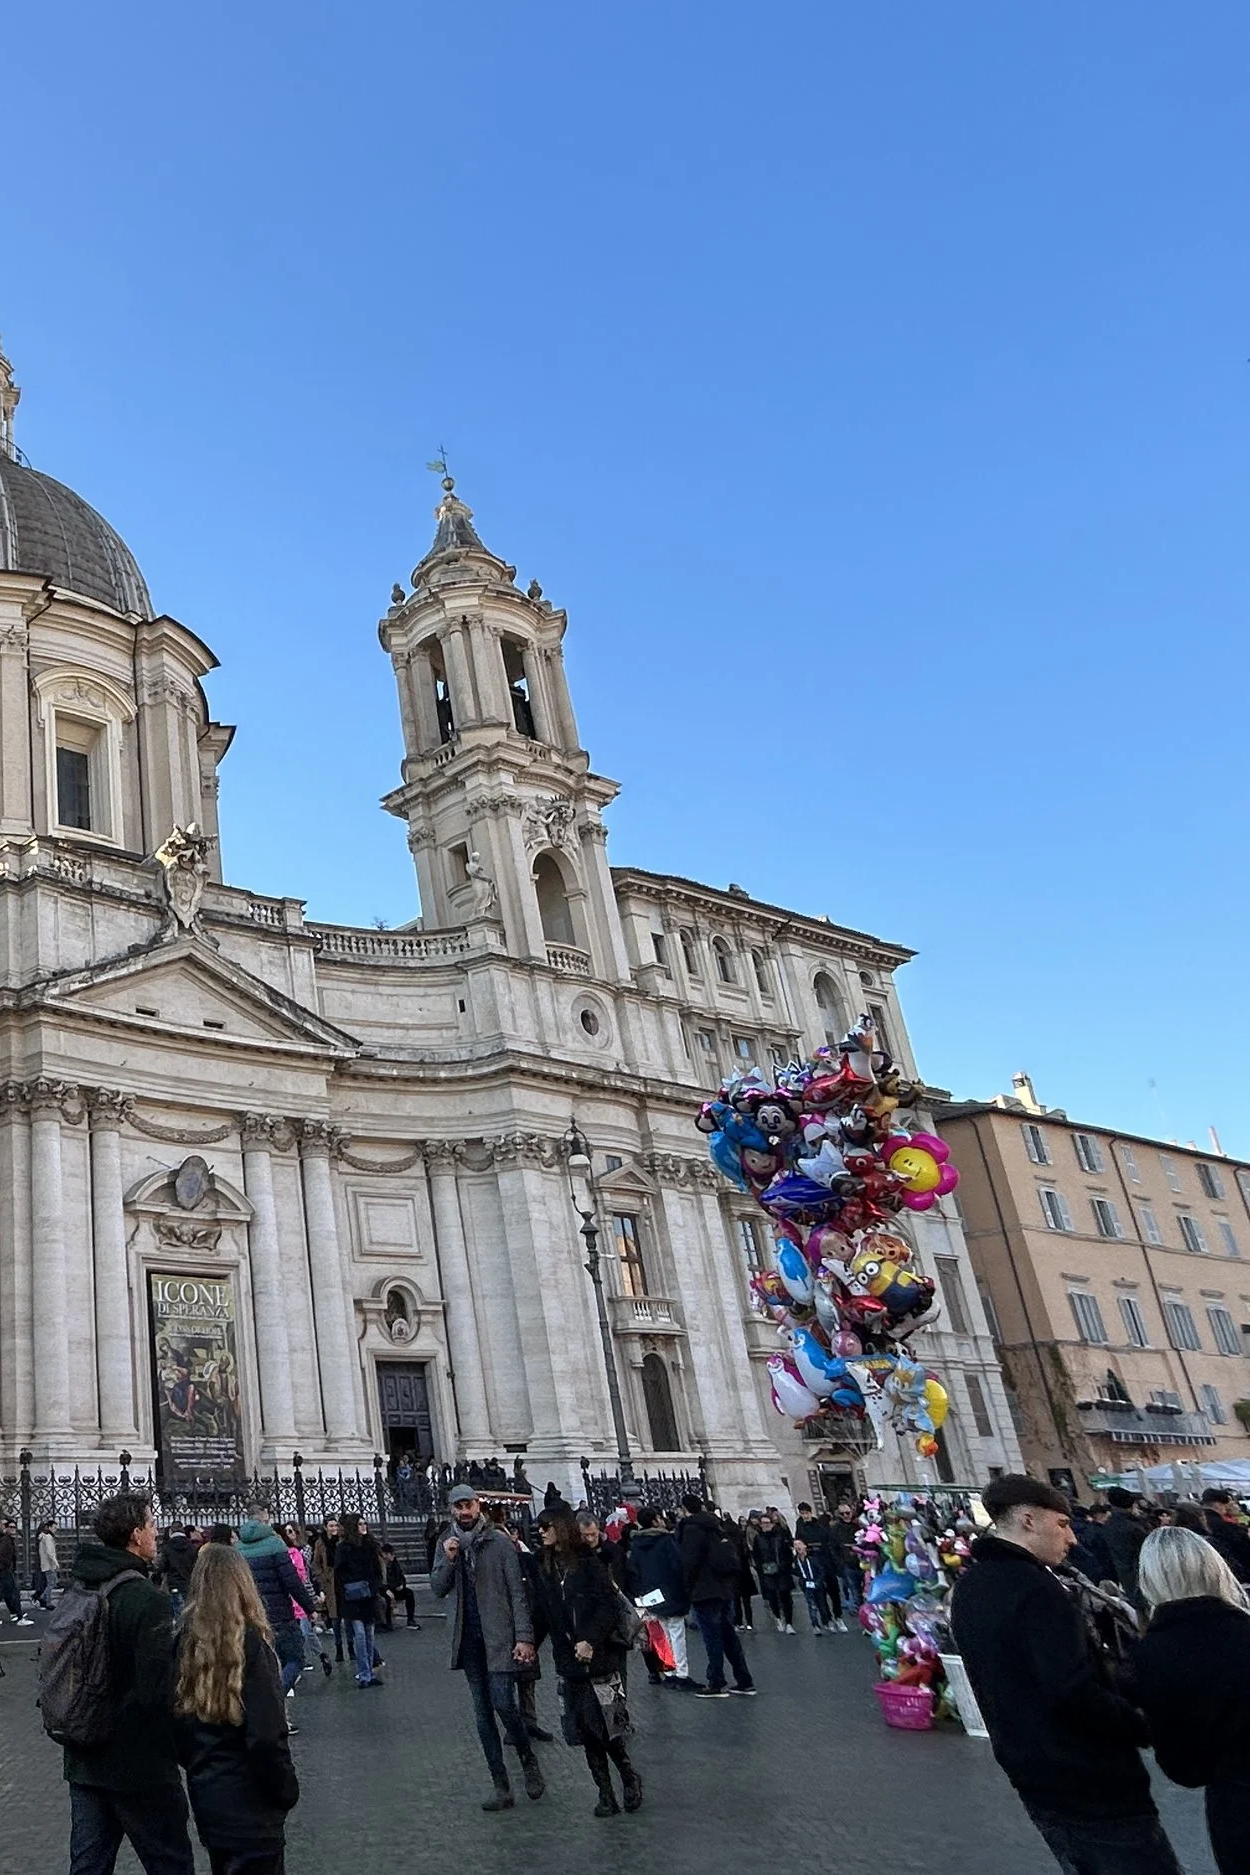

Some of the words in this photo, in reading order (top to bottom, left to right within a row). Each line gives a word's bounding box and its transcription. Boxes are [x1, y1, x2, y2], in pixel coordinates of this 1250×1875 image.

[156, 1280, 229, 1306] ICONE
[158, 1302, 170, 1314] DI
[173, 1303, 230, 1318] SPERANZA
